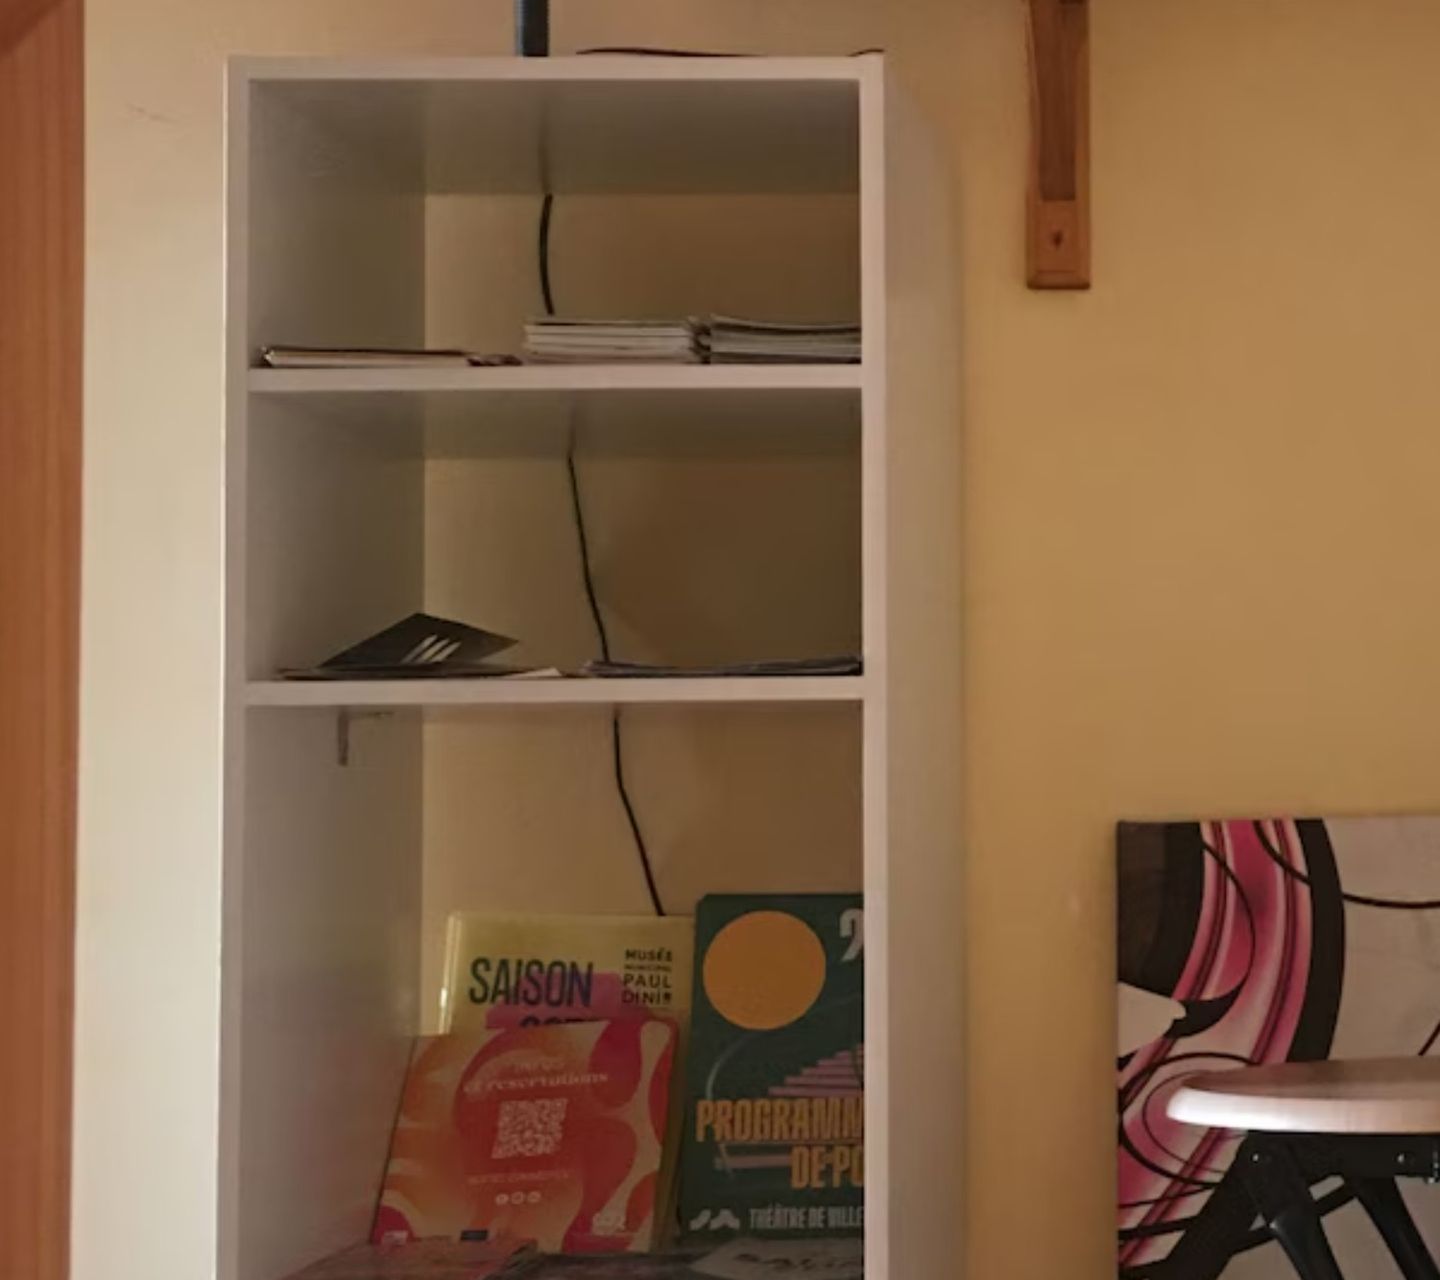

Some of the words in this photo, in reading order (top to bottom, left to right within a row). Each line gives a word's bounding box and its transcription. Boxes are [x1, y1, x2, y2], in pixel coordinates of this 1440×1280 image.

[625, 947, 673, 963] MUSÉE
[469, 957, 594, 1008] SAISON
[623, 973, 672, 989] PAUL
[621, 989, 661, 1005] DINI
[696, 1096, 864, 1143] PROGRAMM
[790, 1146, 825, 1189] DE
[748, 1205, 805, 1230] THÉÂTRE
[806, 1207, 825, 1229] DE
